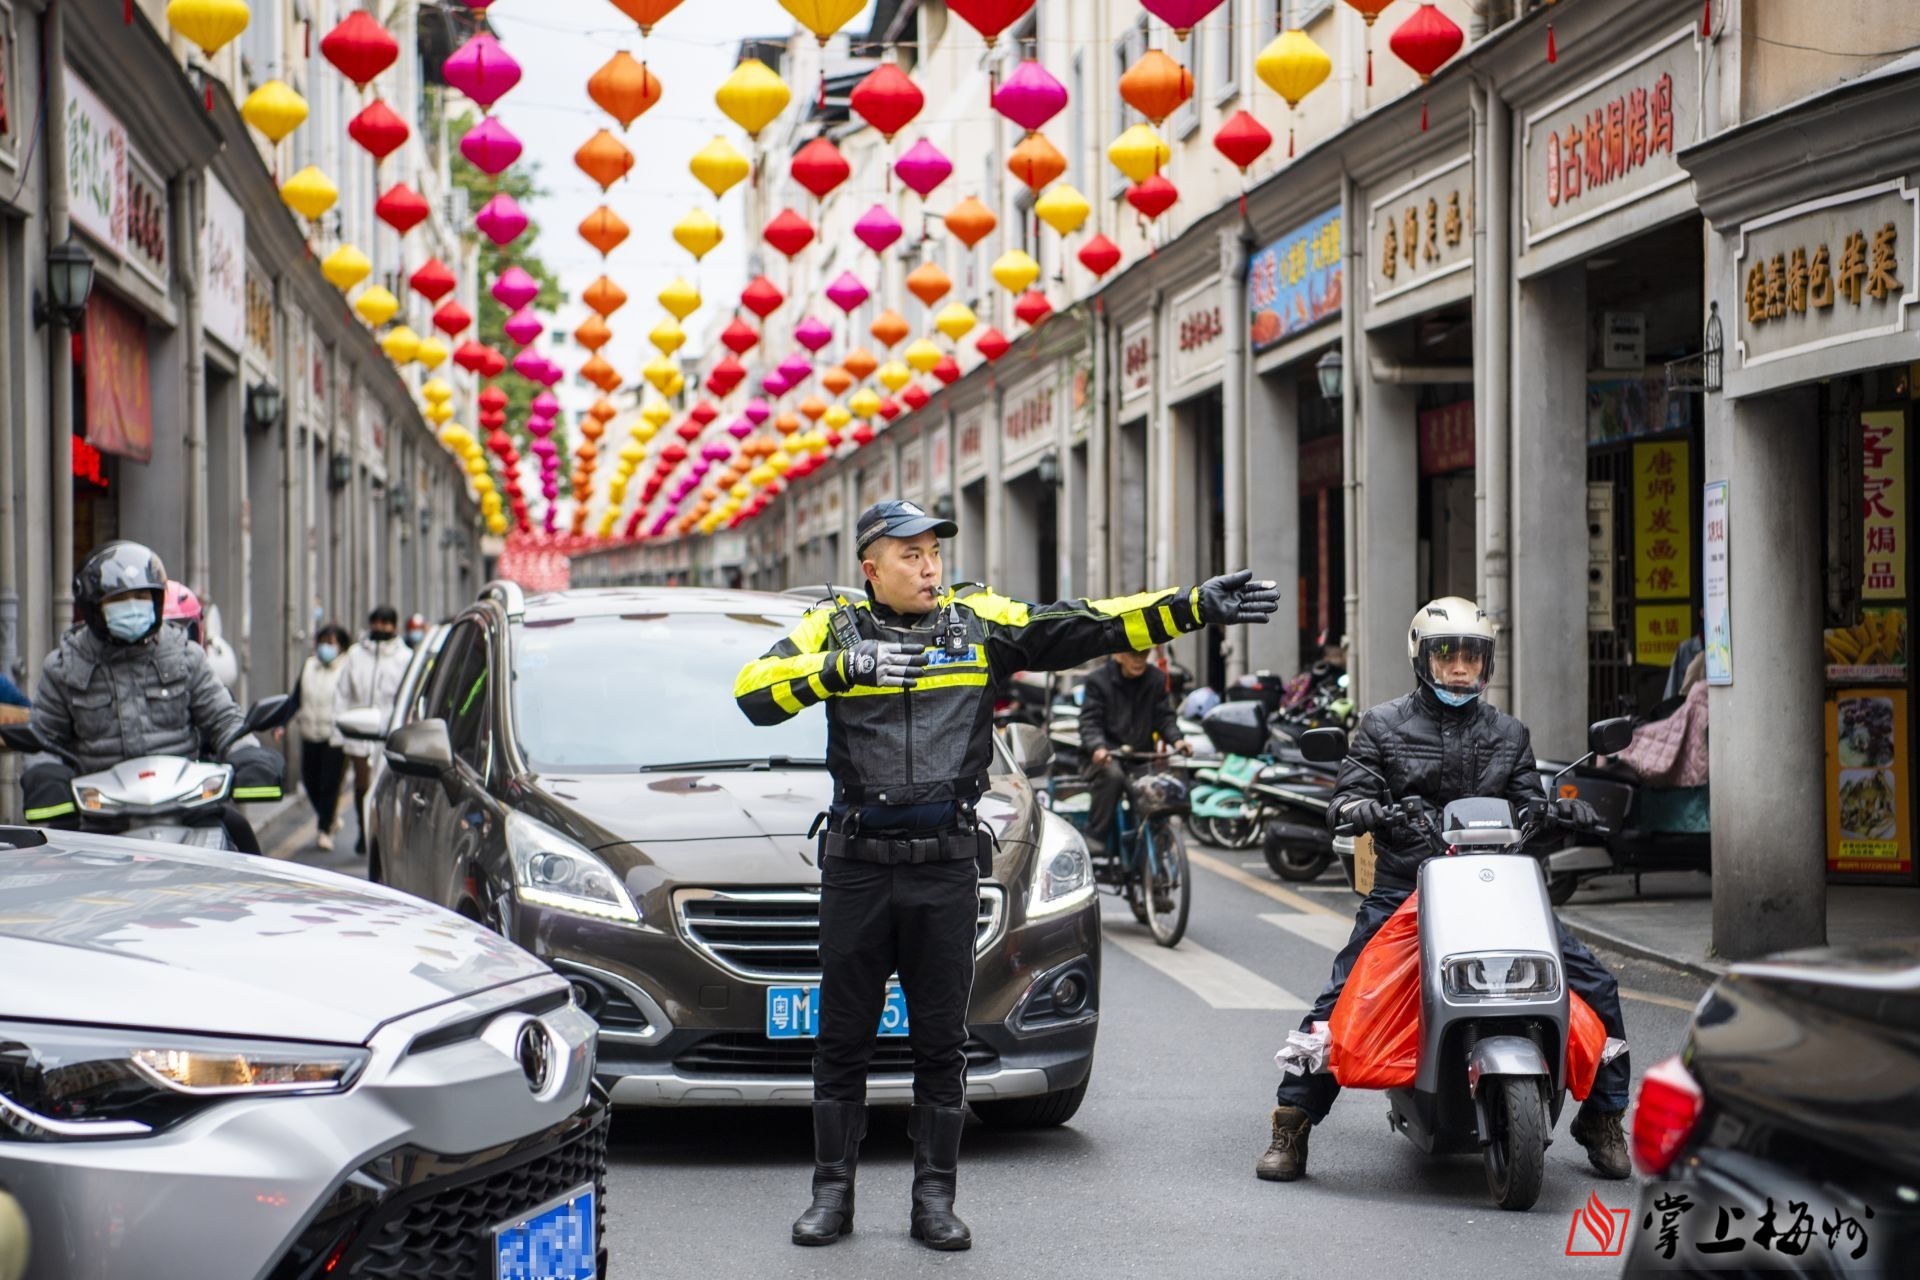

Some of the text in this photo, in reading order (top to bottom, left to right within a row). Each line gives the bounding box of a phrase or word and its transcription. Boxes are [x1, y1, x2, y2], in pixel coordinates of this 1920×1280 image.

[1645, 448, 1679, 592] 唐师炭画像
